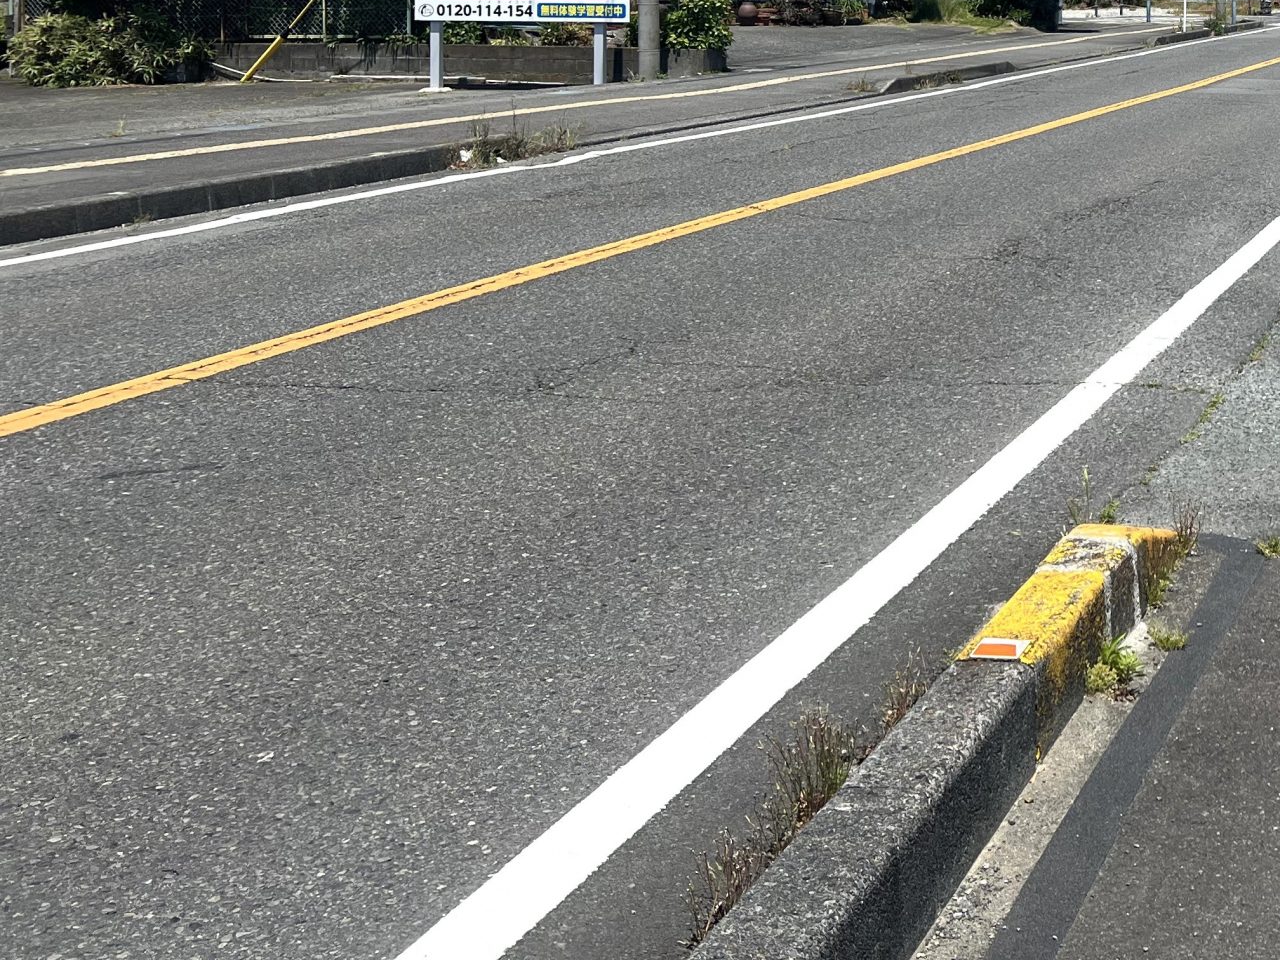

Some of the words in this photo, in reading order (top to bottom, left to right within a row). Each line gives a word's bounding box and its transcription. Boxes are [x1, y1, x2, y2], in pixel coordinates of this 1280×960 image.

[436, 4, 533, 17] 0120-114-154
[540, 5, 623, 17] 無料体験学習受付中
